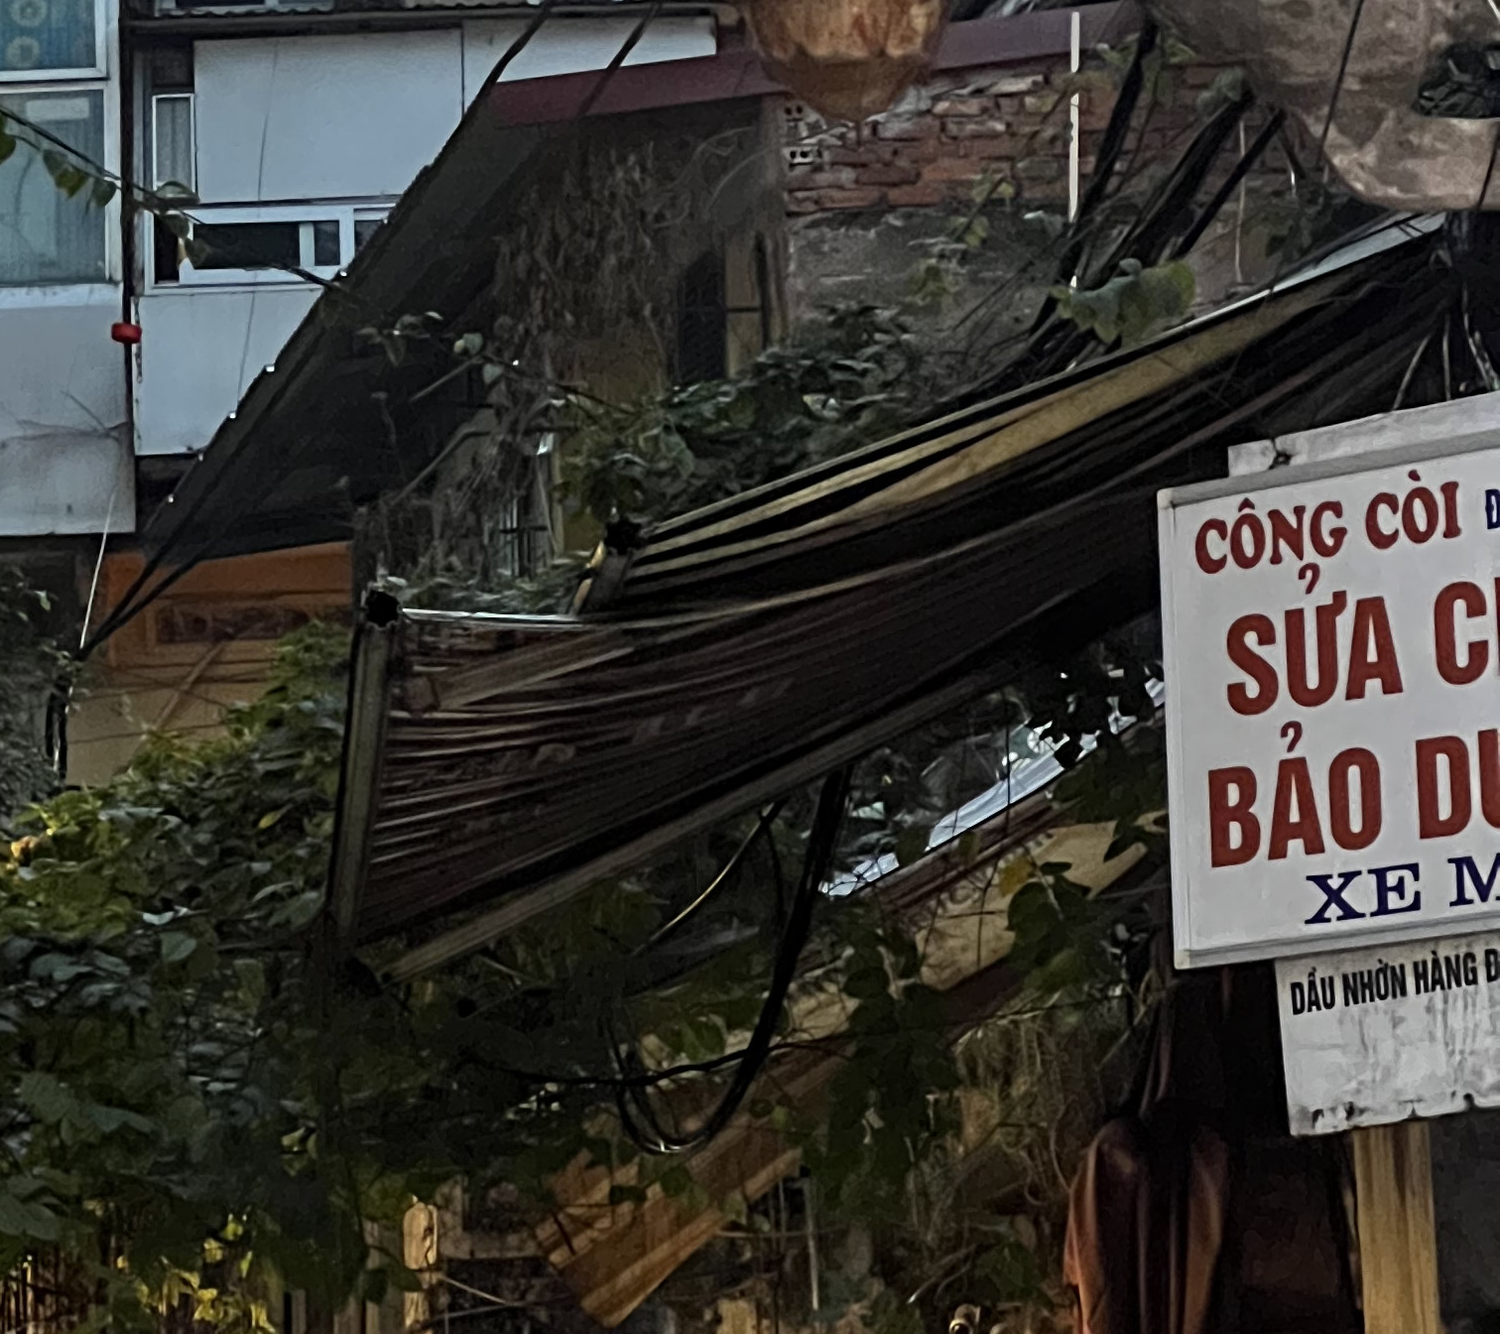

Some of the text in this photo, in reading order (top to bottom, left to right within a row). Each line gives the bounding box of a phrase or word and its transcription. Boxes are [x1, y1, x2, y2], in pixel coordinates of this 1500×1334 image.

[1195, 497, 1347, 574] CÔNG
[1366, 469, 1462, 549] CÒI
[1227, 562, 1500, 715] SỬA C
[1208, 721, 1382, 868] BẢO
[1304, 862, 1421, 924] XE
[1412, 950, 1479, 995] HÀNG
